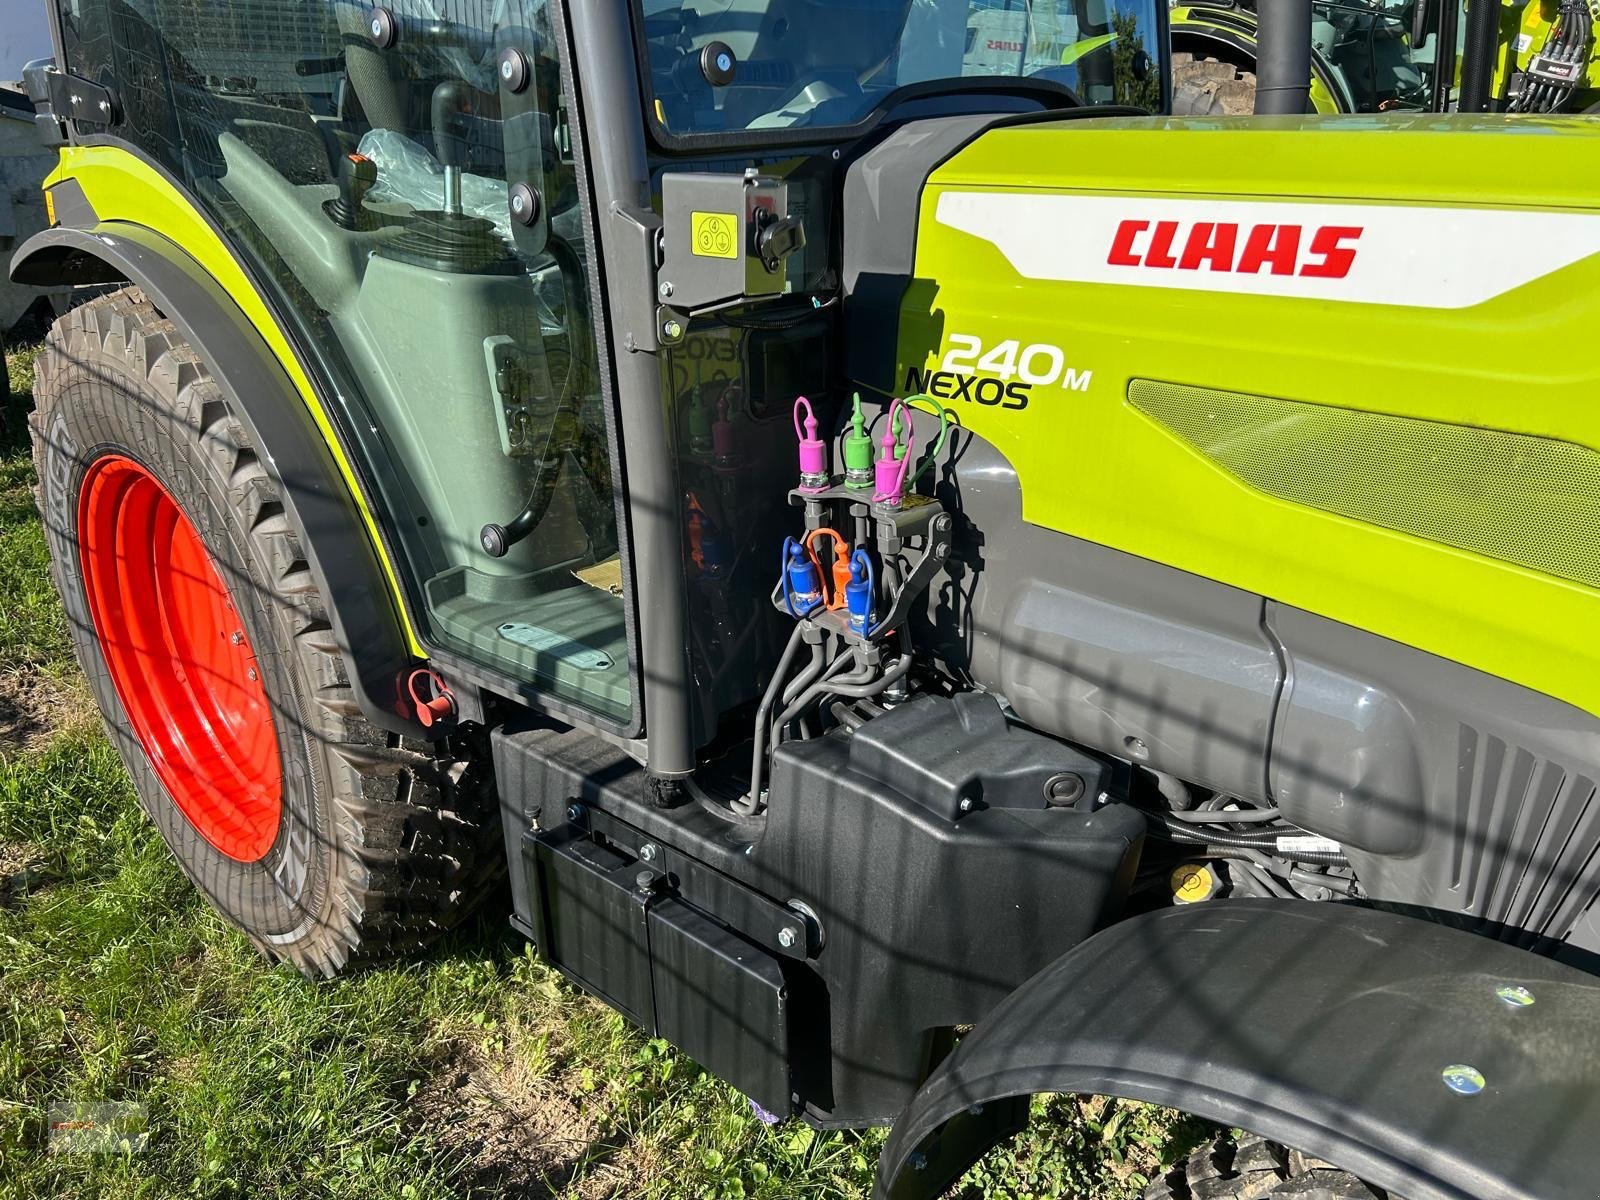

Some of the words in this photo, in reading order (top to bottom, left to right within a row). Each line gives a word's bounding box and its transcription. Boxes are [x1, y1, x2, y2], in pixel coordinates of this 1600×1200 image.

[1107, 219, 1364, 279] CLAAS
[941, 333, 1065, 386] 240
[904, 366, 1033, 411] NEXOS
